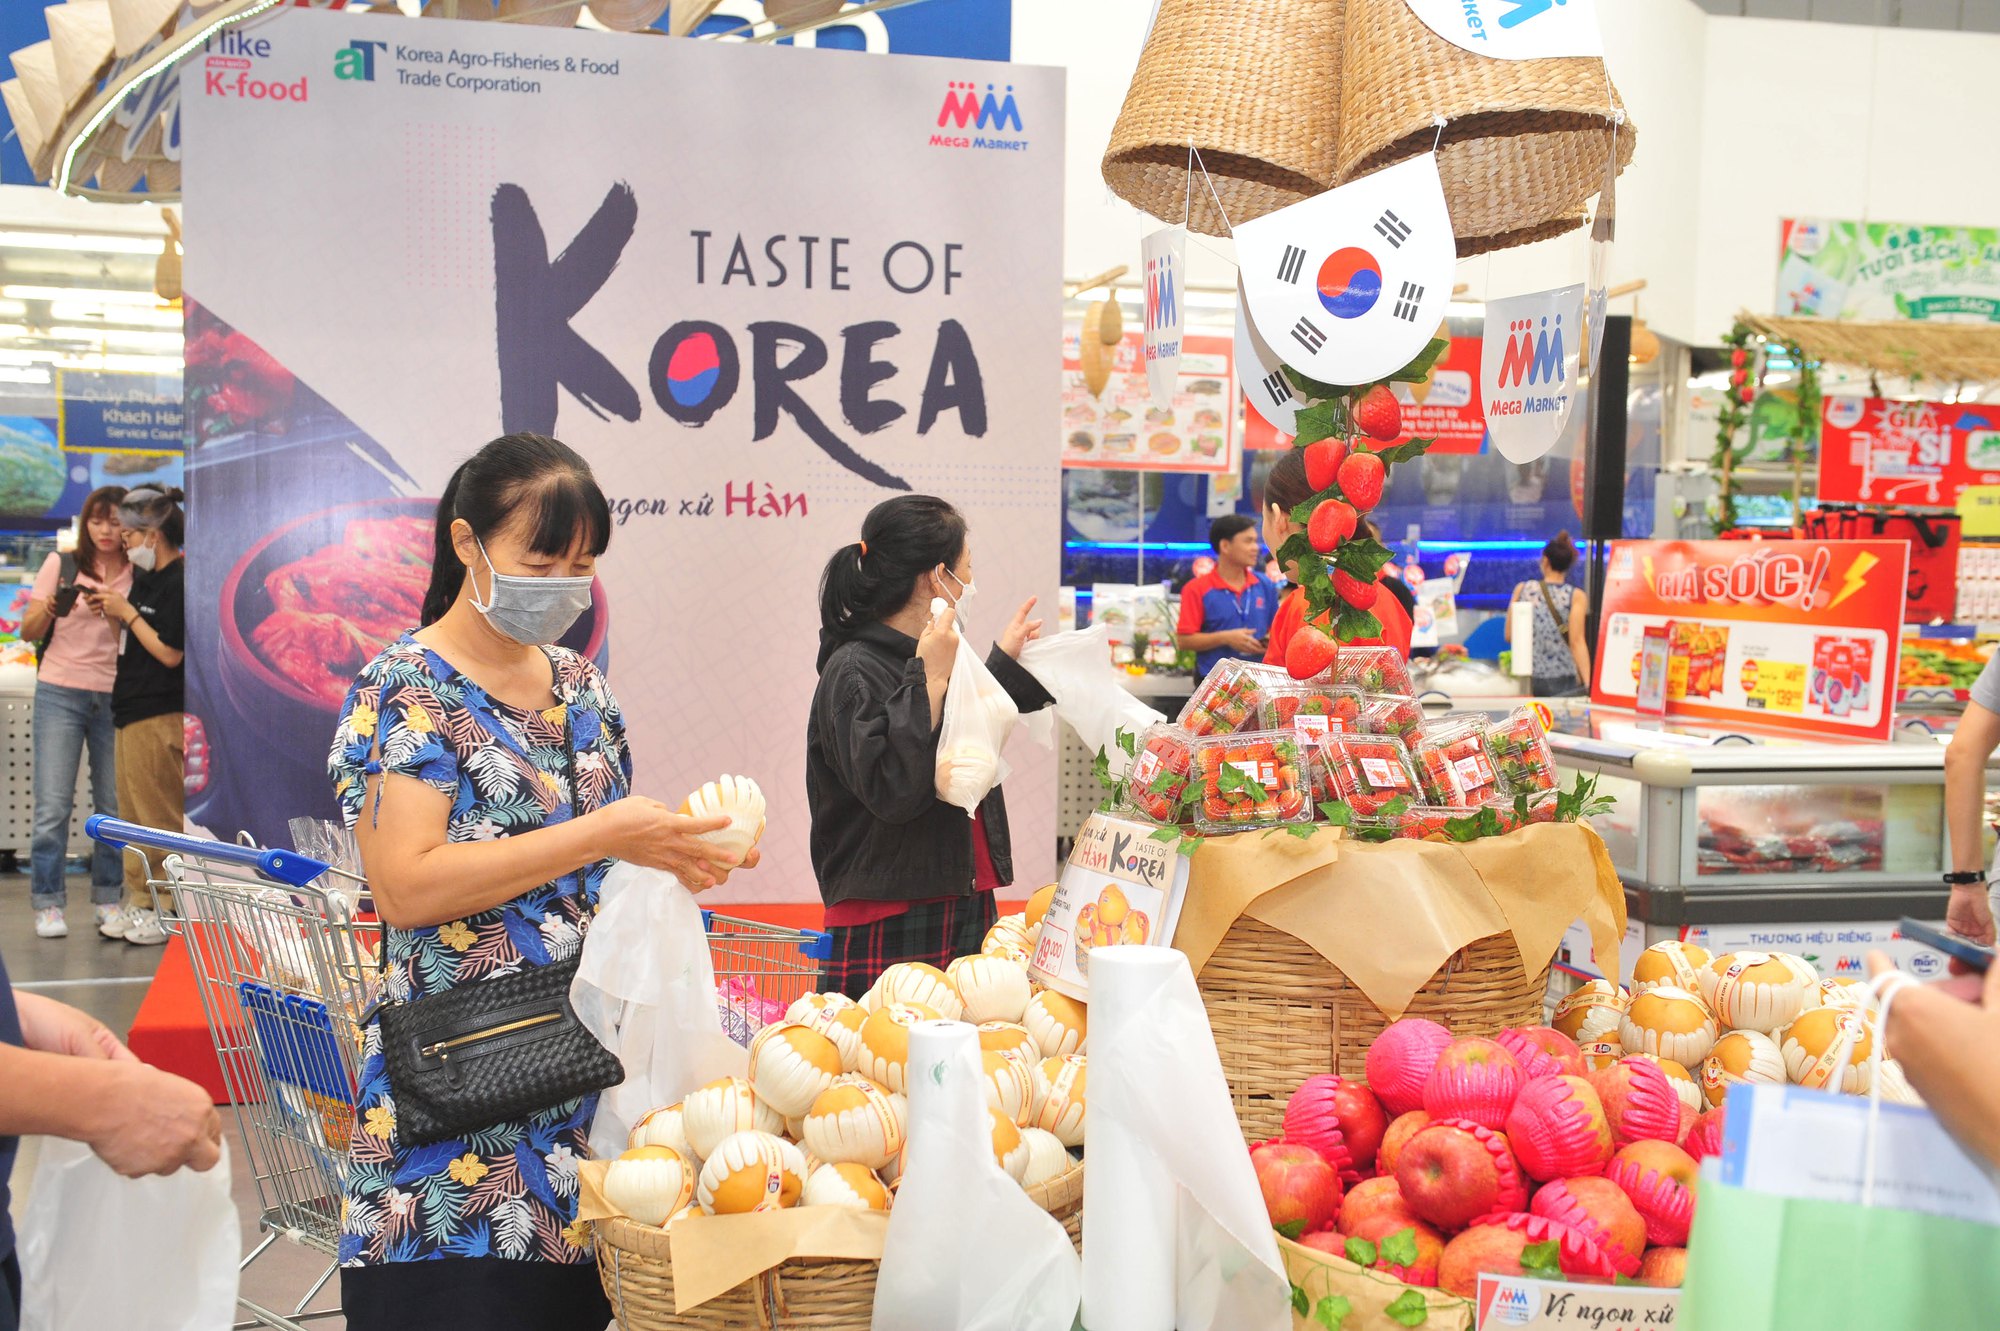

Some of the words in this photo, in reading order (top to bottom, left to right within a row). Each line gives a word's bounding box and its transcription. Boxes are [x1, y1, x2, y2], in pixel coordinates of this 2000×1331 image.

[220, 29, 271, 58] like
[396, 45, 444, 63] Korea
[448, 49, 560, 72] Agro-Fisheries
[564, 57, 576, 73] &
[581, 58, 619, 75] Food
[205, 71, 308, 102] K-food
[397, 69, 442, 87] Trade
[446, 72, 541, 94] Corporation
[690, 229, 851, 291] TASTE
[882, 240, 964, 296] OF
[490, 178, 989, 492] KOREA
[151, 427, 183, 441] Count
[724, 480, 809, 518] Hàn
[1109, 831, 1166, 888] KOREA
[1544, 1292, 1576, 1322] Vị
[1576, 1305, 1636, 1330] ngon
[1644, 1303, 1675, 1324] xứ
